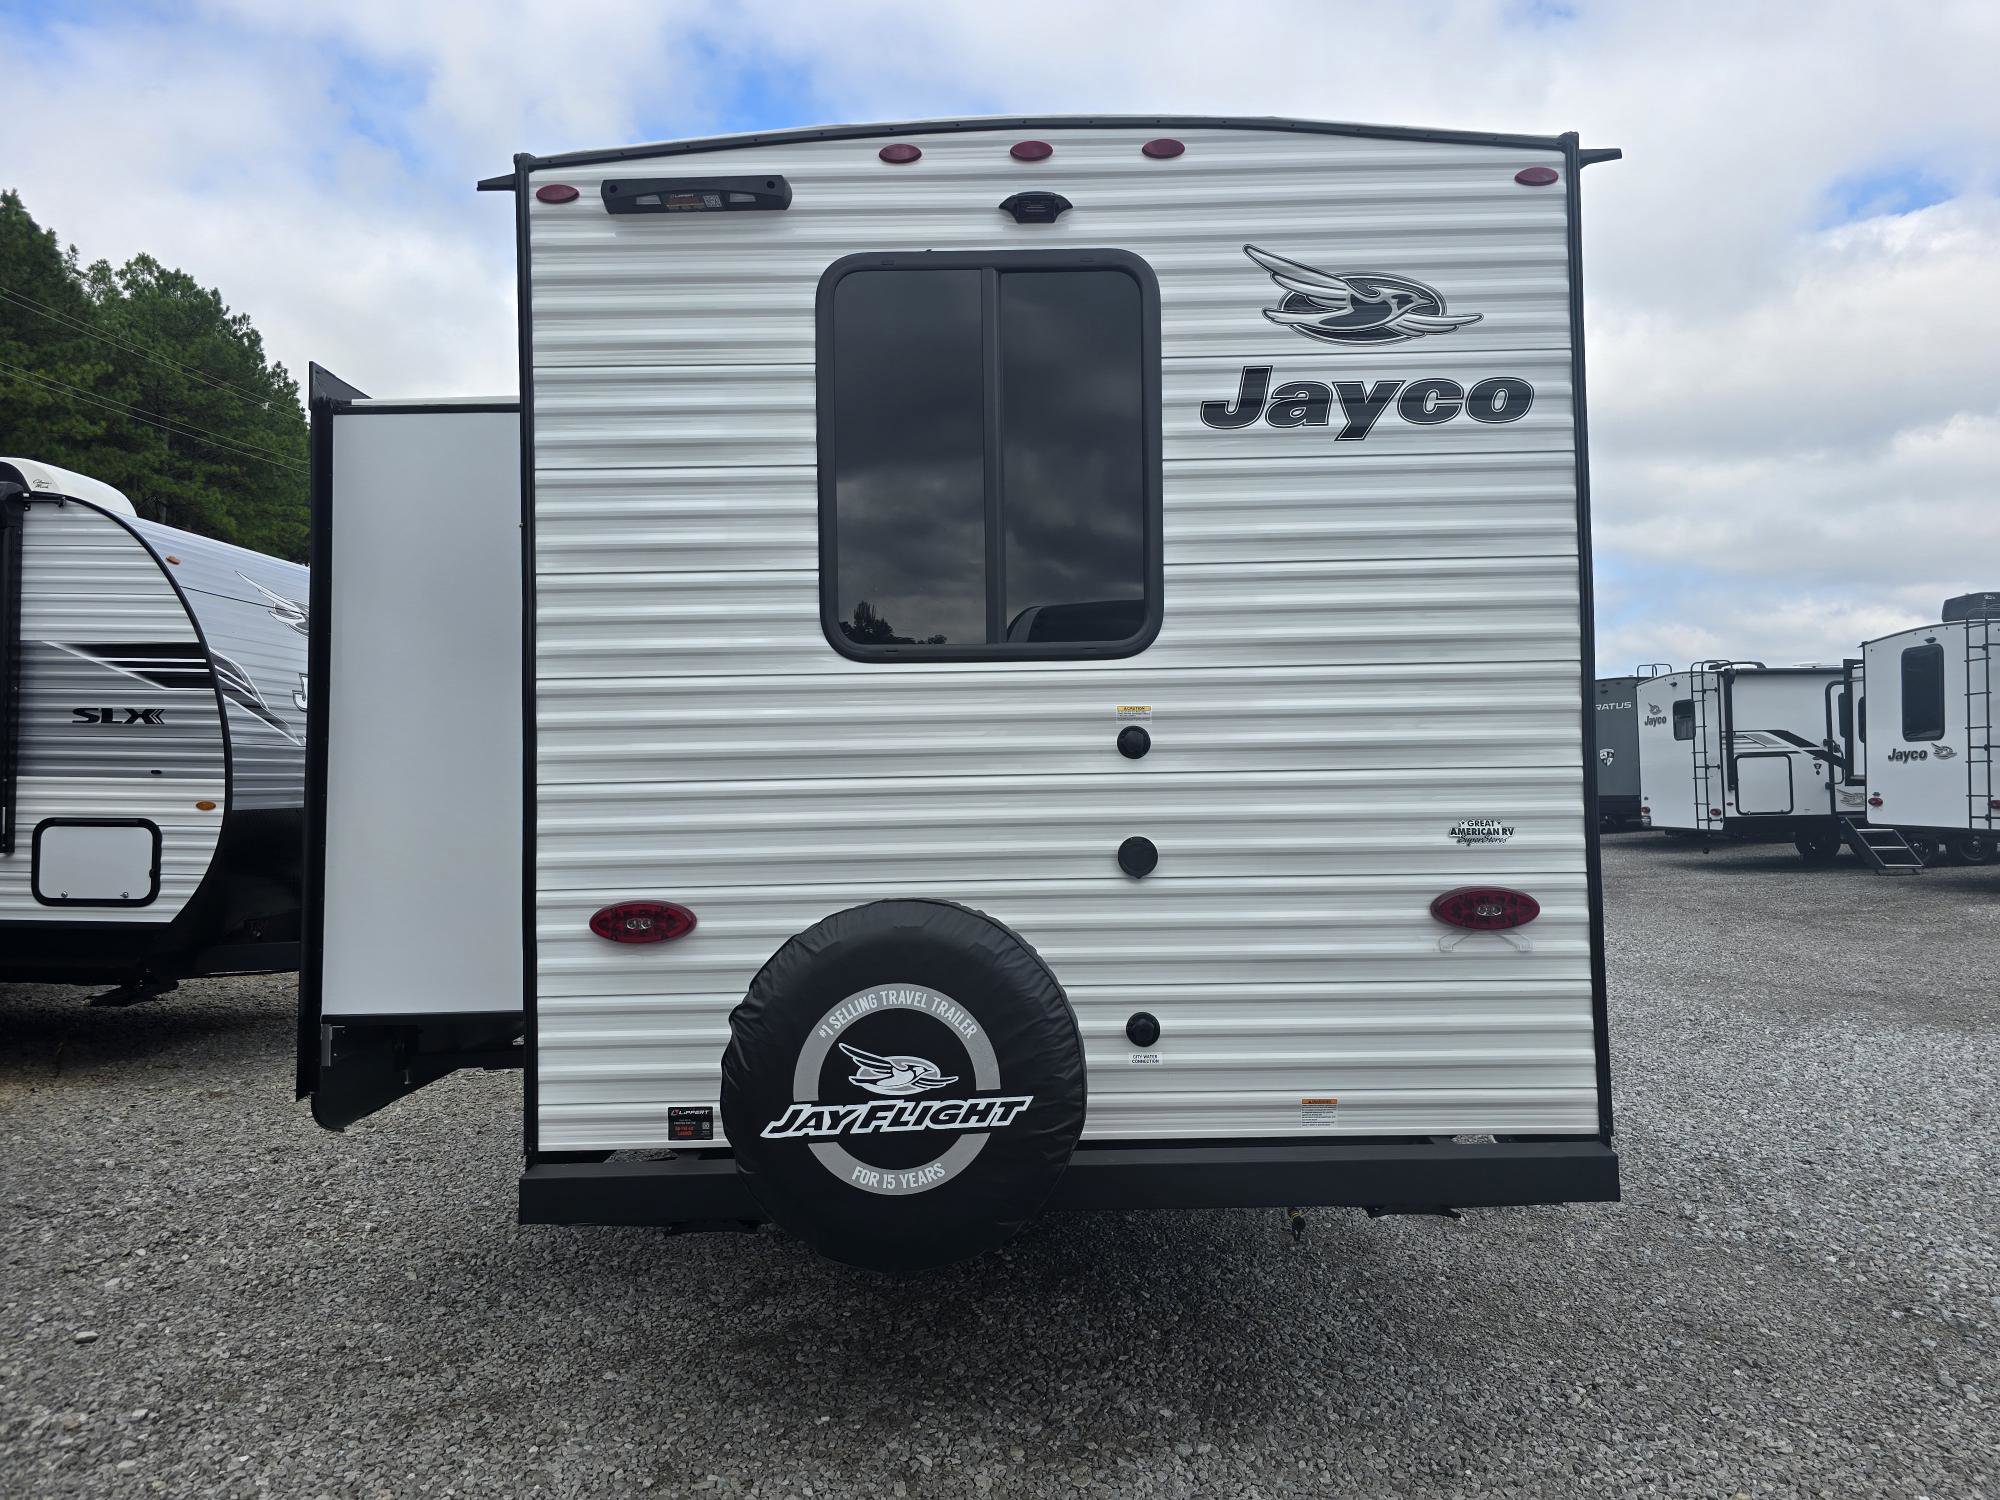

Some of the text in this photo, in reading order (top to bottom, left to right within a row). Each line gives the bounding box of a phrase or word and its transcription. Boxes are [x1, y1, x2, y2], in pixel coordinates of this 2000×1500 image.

[1200, 365, 1535, 441] Jayco
[72, 707, 165, 725] SLX
[1644, 715, 1667, 728] Jayco
[1887, 748, 1928, 764] Jayco
[1450, 827, 1515, 836] AMERICAN RV
[818, 990, 978, 1039] #1 SELLING TRAVEL TRAILER
[852, 1162, 946, 1189] FOR 15 YEARS
